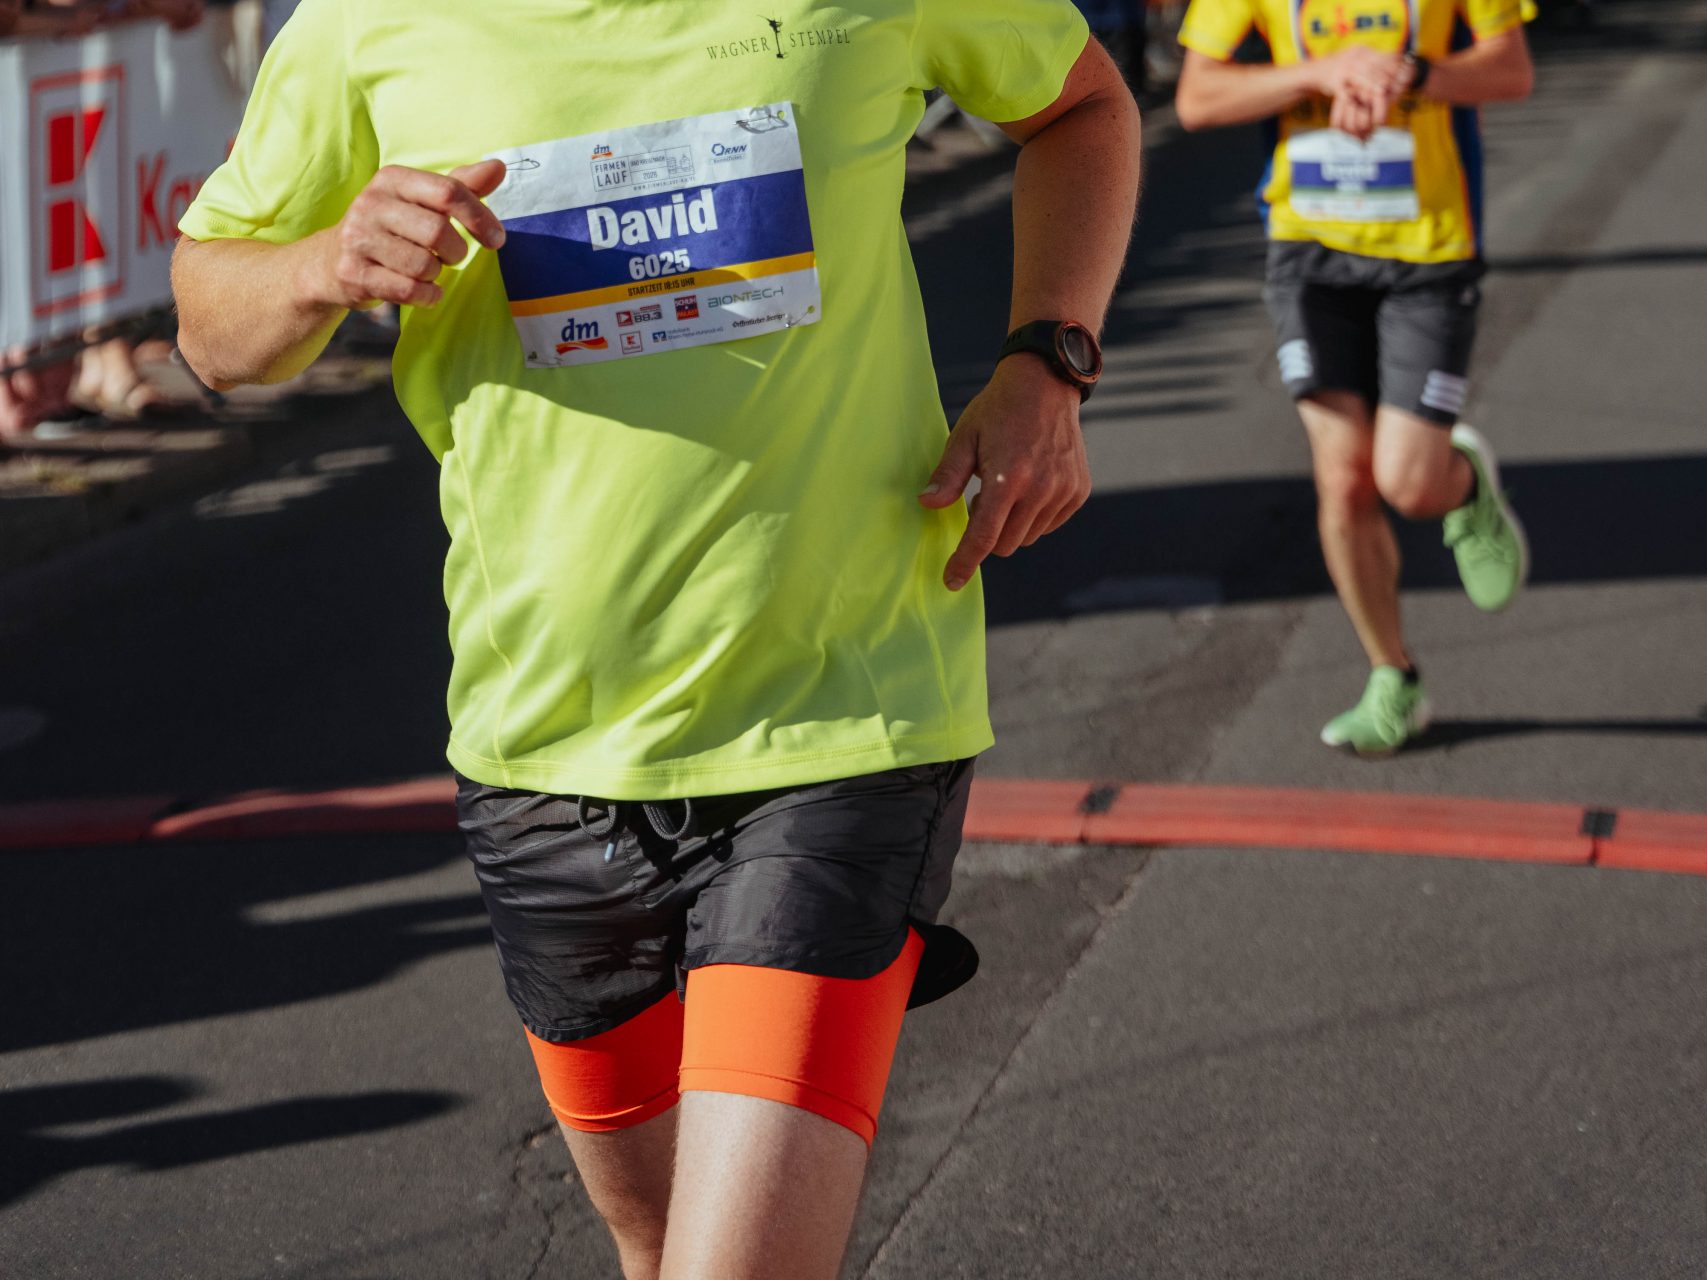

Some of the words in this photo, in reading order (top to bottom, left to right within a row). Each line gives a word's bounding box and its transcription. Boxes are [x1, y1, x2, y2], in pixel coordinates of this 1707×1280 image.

[707, 37, 771, 60] WAGNER
[789, 28, 850, 48] STEMPEL
[593, 144, 610, 155] dm
[594, 160, 626, 173] FIRMEN
[596, 170, 627, 187] LAUF
[136, 151, 204, 252] Ka
[586, 188, 718, 252] David
[628, 248, 691, 280] 6025
[627, 282, 663, 297] STARTZEIT
[681, 277, 695, 288] UHR
[708, 286, 784, 308] BIONTECH
[634, 311, 663, 323] 88.3
[561, 317, 599, 342] dm
